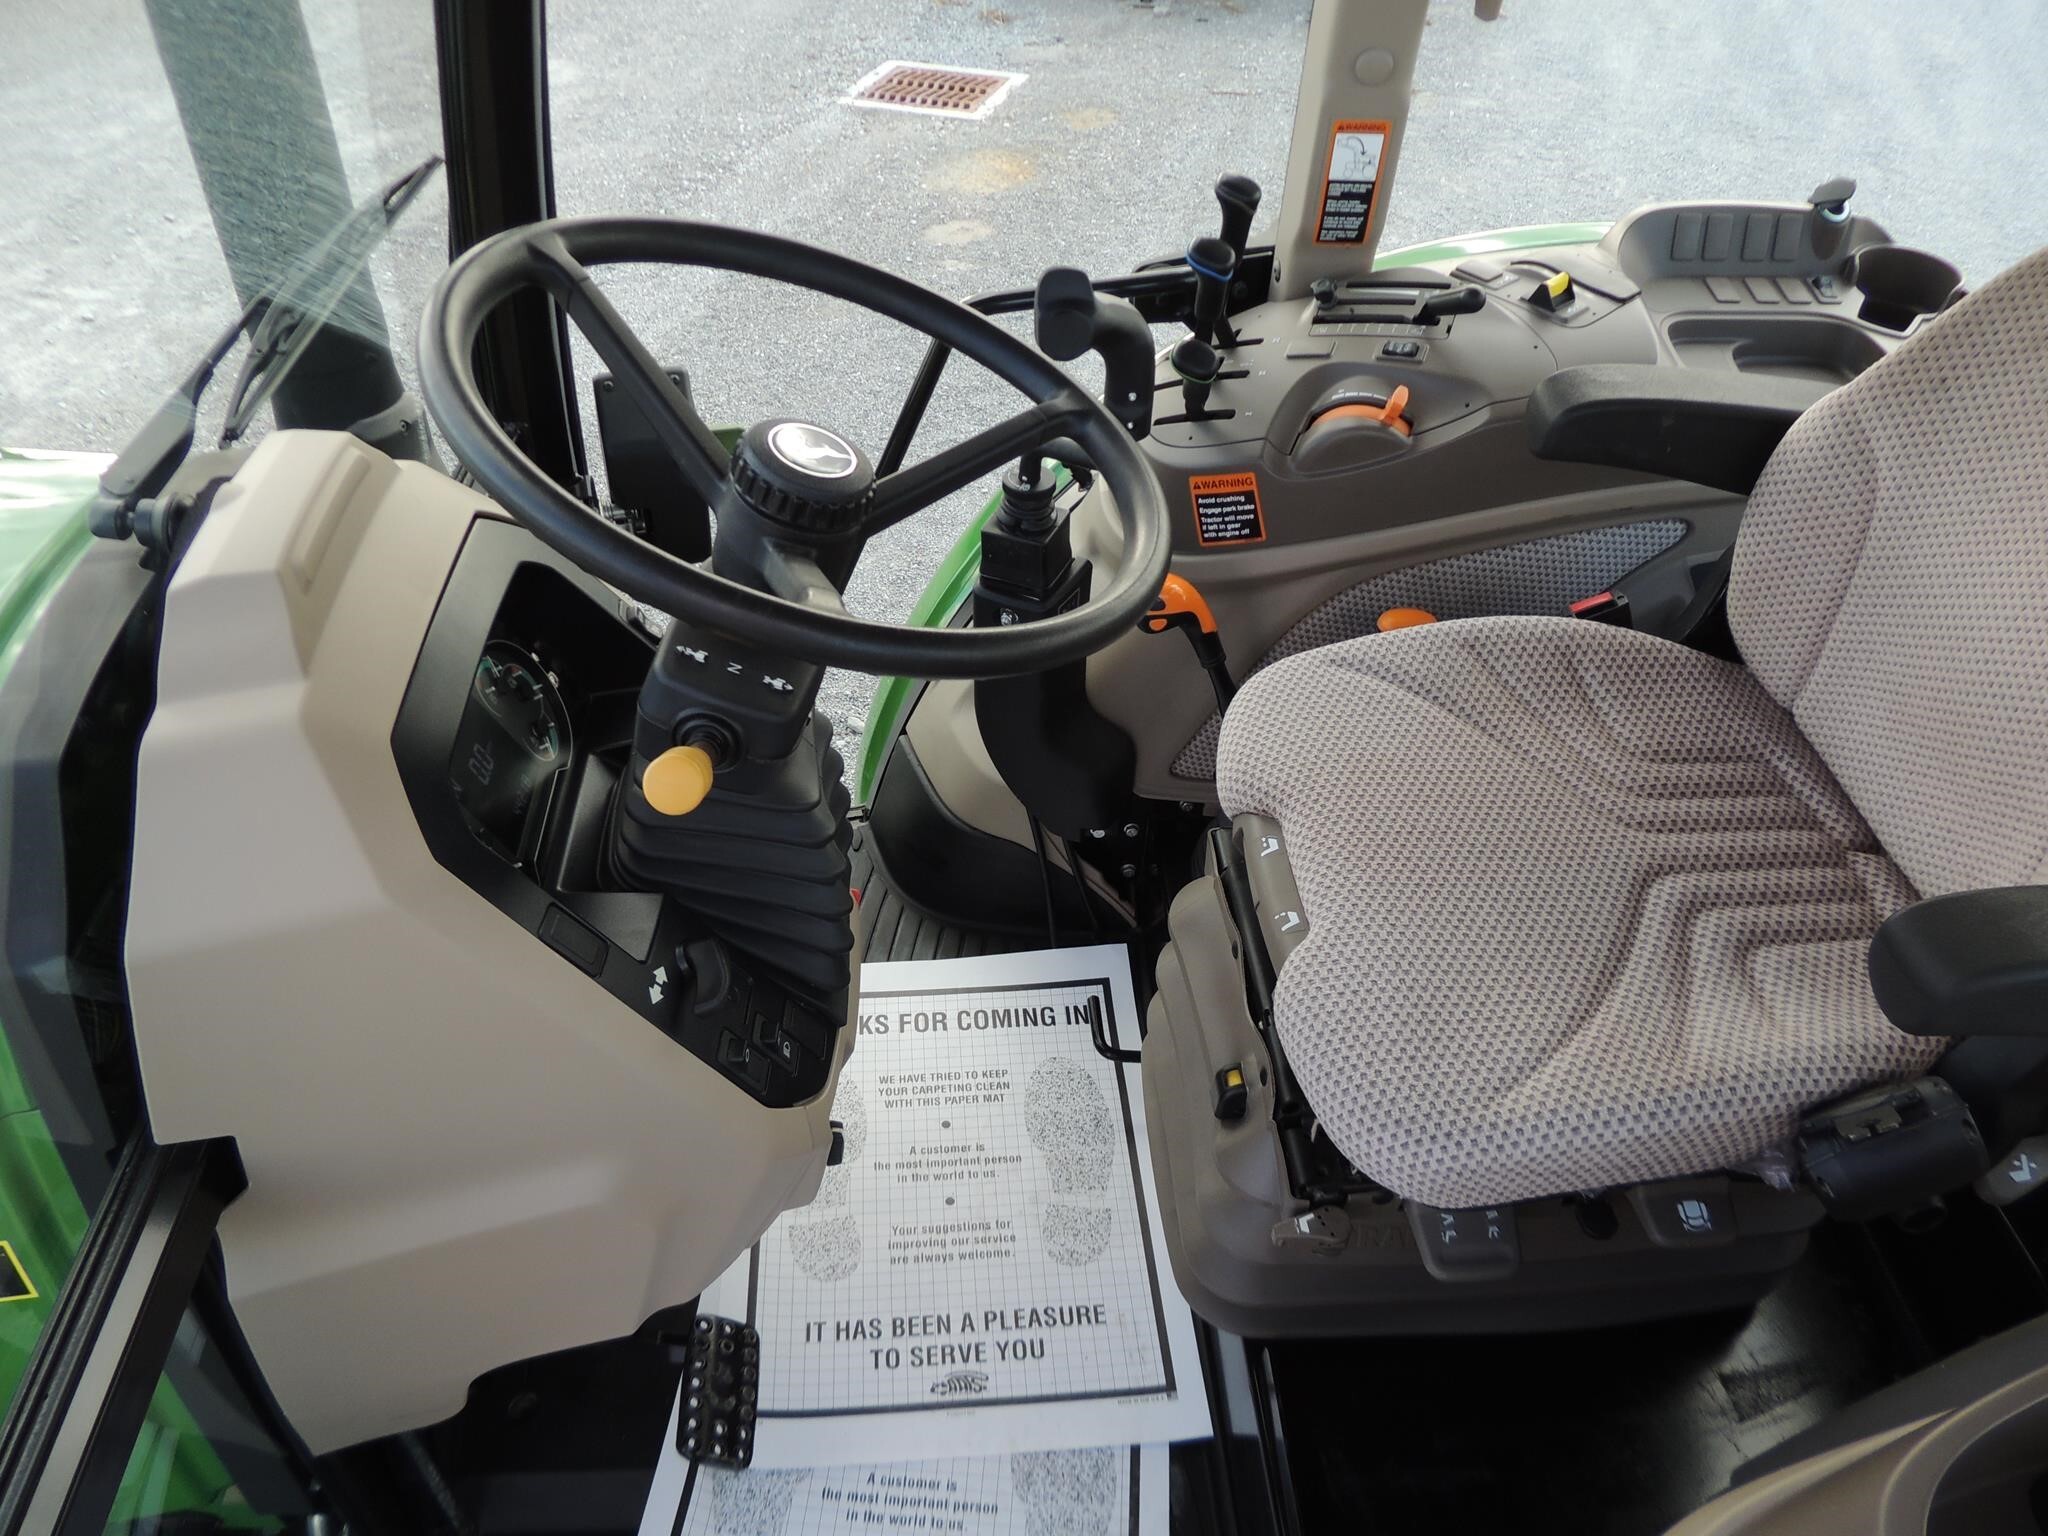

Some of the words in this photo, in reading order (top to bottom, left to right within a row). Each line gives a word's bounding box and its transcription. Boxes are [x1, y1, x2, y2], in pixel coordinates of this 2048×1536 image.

[1201, 477, 1253, 489] WARNING
[1216, 495, 1245, 503] crushing
[1227, 522, 1241, 530] gear
[900, 1012, 947, 1033] FOR
[957, 1007, 1056, 1031] COMING
[1065, 1005, 1090, 1025] IN
[879, 1075, 895, 1084] WE
[900, 1074, 926, 1084] HAVE
[930, 1072, 961, 1081] TRIED
[965, 1071, 978, 1080] TO
[982, 1069, 1008, 1079] KEEP
[878, 1087, 908, 1096] YOUR
[912, 1083, 972, 1095] CARPETING
[976, 1082, 1010, 1091] CLEAN
[884, 1099, 912, 1108] WITH
[917, 1097, 940, 1107] THIS
[945, 1095, 979, 1105] PAPER
[983, 1094, 1005, 1103] MAT
[909, 1146, 916, 1156] A
[920, 1144, 972, 1155] customer
[976, 1142, 985, 1152] is
[874, 1161, 891, 1171] the
[895, 1160, 922, 1170] most
[926, 1156, 981, 1169] important
[984, 1155, 1022, 1166] person
[897, 1174, 908, 1183] in
[912, 1173, 929, 1182] the
[933, 1170, 964, 1181] world
[968, 1170, 979, 1179] to
[983, 1170, 1001, 1178] us.
[892, 1225, 917, 1236] Your
[922, 1221, 991, 1234] suggestions
[995, 1219, 1011, 1230] for
[888, 1238, 947, 1250] improving
[951, 1237, 969, 1246] our
[974, 1233, 1016, 1244] service
[890, 1256, 909, 1265] are
[913, 1253, 954, 1264] always
[958, 1249, 1015, 1261] welcome.
[805, 1321, 826, 1343] IT
[836, 1318, 883, 1341] HAS
[892, 1313, 951, 1339] BEEN
[960, 1312, 975, 1333] A
[984, 1304, 1106, 1332] PLEASURE
[870, 1349, 900, 1370] TO
[910, 1341, 988, 1368] SERVE
[996, 1337, 1046, 1361] YOU
[867, 1472, 875, 1485] A
[880, 1475, 941, 1490] customer
[946, 1480, 958, 1492] is
[822, 1487, 842, 1500] the
[847, 1492, 879, 1504] most
[884, 1494, 949, 1511] important
[953, 1501, 998, 1515] person
[846, 1509, 858, 1522] in
[863, 1509, 884, 1524] the
[889, 1512, 926, 1528] world
[931, 1516, 943, 1529] to
[948, 1520, 968, 1532] us.
